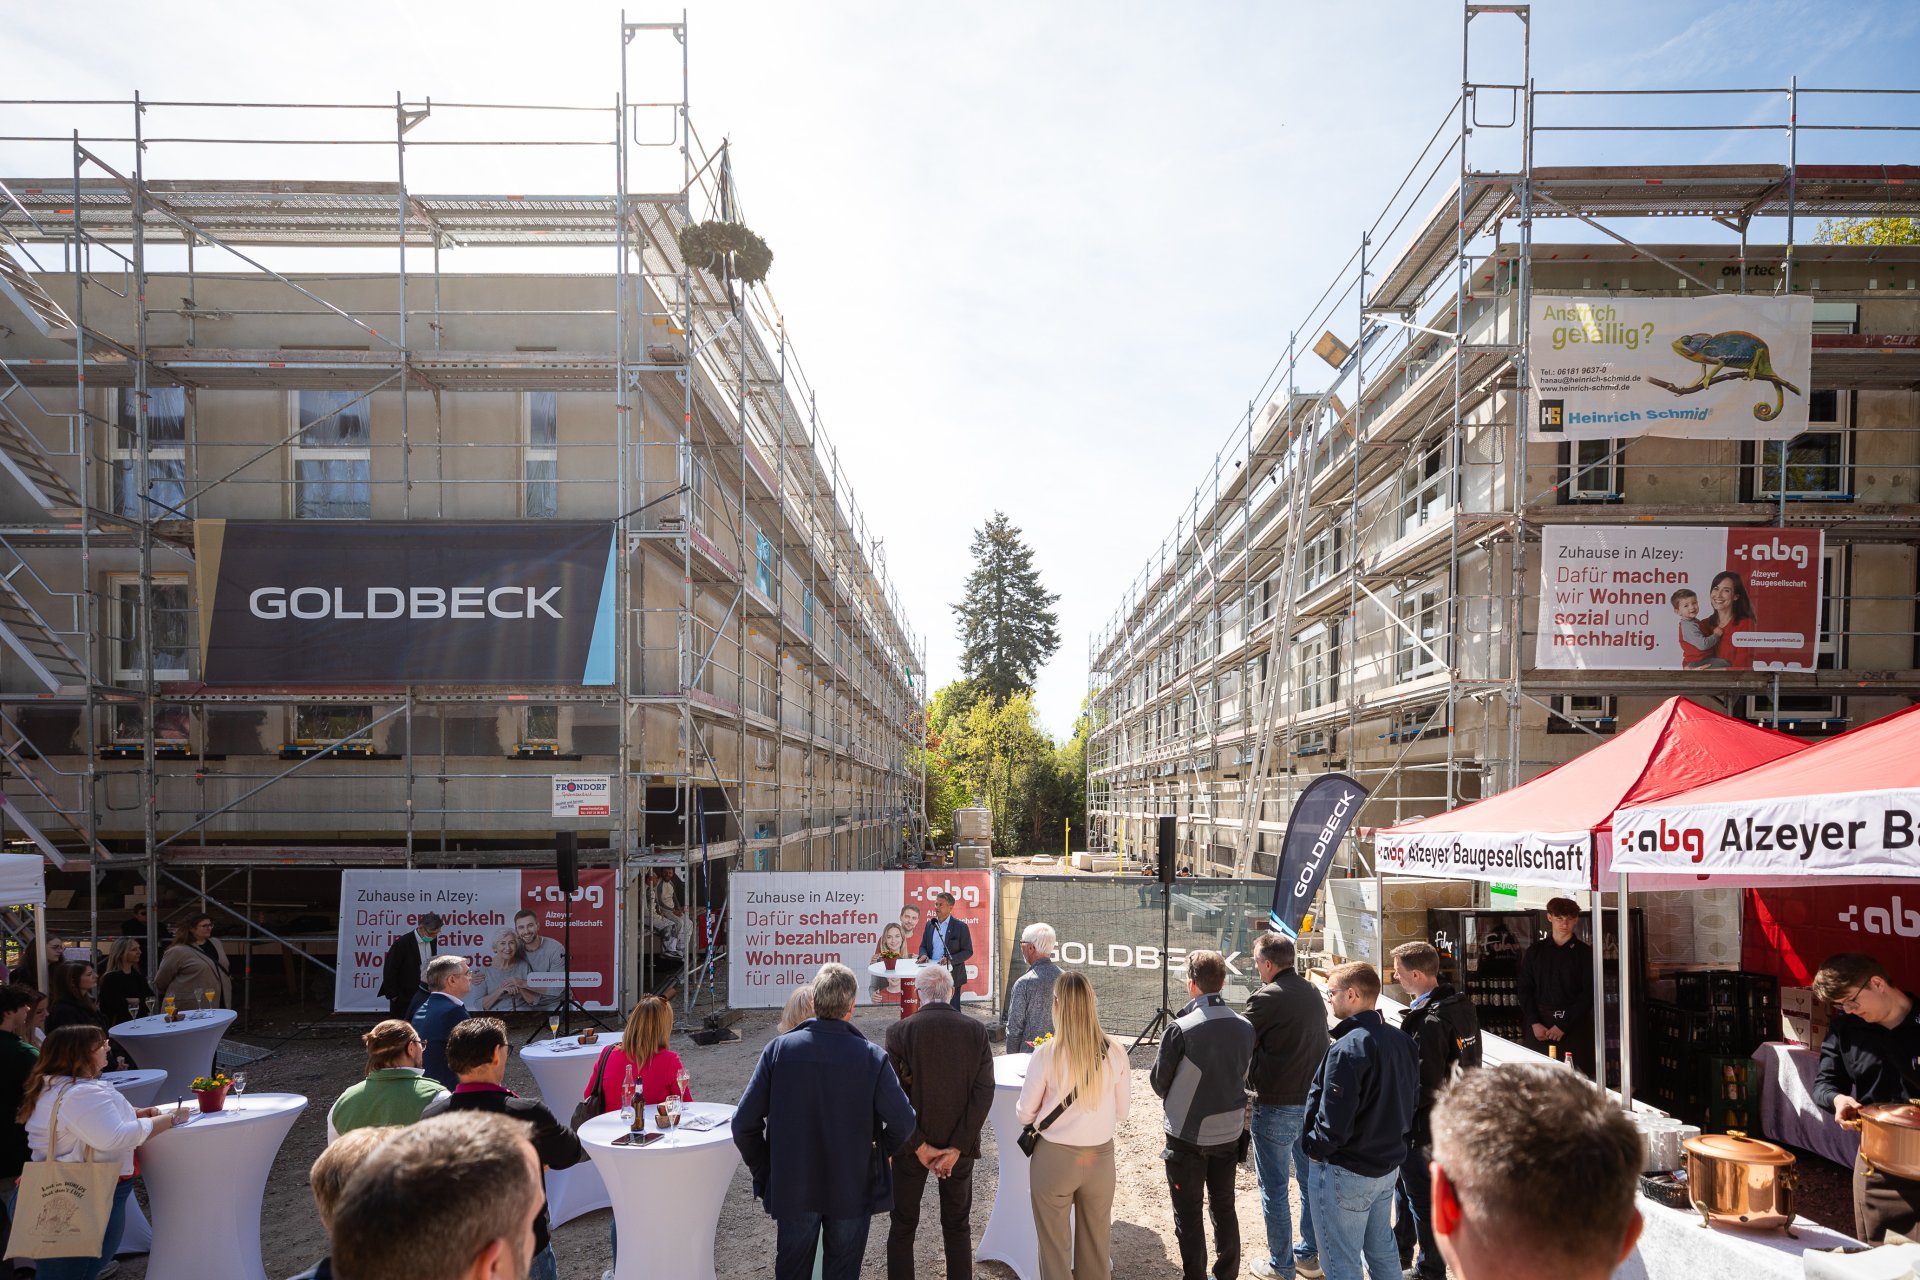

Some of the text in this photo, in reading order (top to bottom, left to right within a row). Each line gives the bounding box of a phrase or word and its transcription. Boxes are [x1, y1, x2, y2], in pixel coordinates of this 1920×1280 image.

[1543, 304, 1616, 321] Anstrich
[1552, 322, 1655, 351] gefällig?
[1540, 375, 1641, 384] hanau@heinrich-schmid.de
[1541, 367, 1607, 376] Tel.: 06181 9637-0
[1540, 383, 1630, 392] www.heinrich-schmid.de
[1541, 407, 1561, 425] HS
[1568, 410, 1641, 425] Heinrich
[1558, 545, 1684, 563] Zuhause in Alzey:
[1752, 537, 1809, 569] abg
[1557, 566, 1689, 584] Dafür machen
[1751, 570, 1780, 579] Alzeyer
[1750, 580, 1807, 588] Baugesellschaft
[249, 586, 564, 620] GOLDBECK
[1556, 588, 1666, 605] wir Wohnen
[1554, 609, 1649, 626] sozial und
[1553, 630, 1660, 651] nachhaltig.
[555, 783, 607, 792] FRONDORF
[1294, 790, 1356, 898] GOLDBECK
[1638, 818, 1704, 864] abg
[1719, 817, 1867, 860] Alzeyer
[1408, 843, 1450, 868] Alzeyer
[1453, 842, 1583, 872] Baugesellschaft
[357, 889, 479, 905] Zuhause in Alzey:
[746, 891, 865, 905] Zuhause in Alzey:
[356, 909, 402, 926] Dafür
[746, 909, 878, 927] Dafür schaffen
[355, 931, 382, 947] wir
[746, 929, 877, 947] wir bezahlbaren
[745, 950, 841, 967] Wohnraum
[353, 973, 380, 989] für
[746, 970, 771, 986] für
